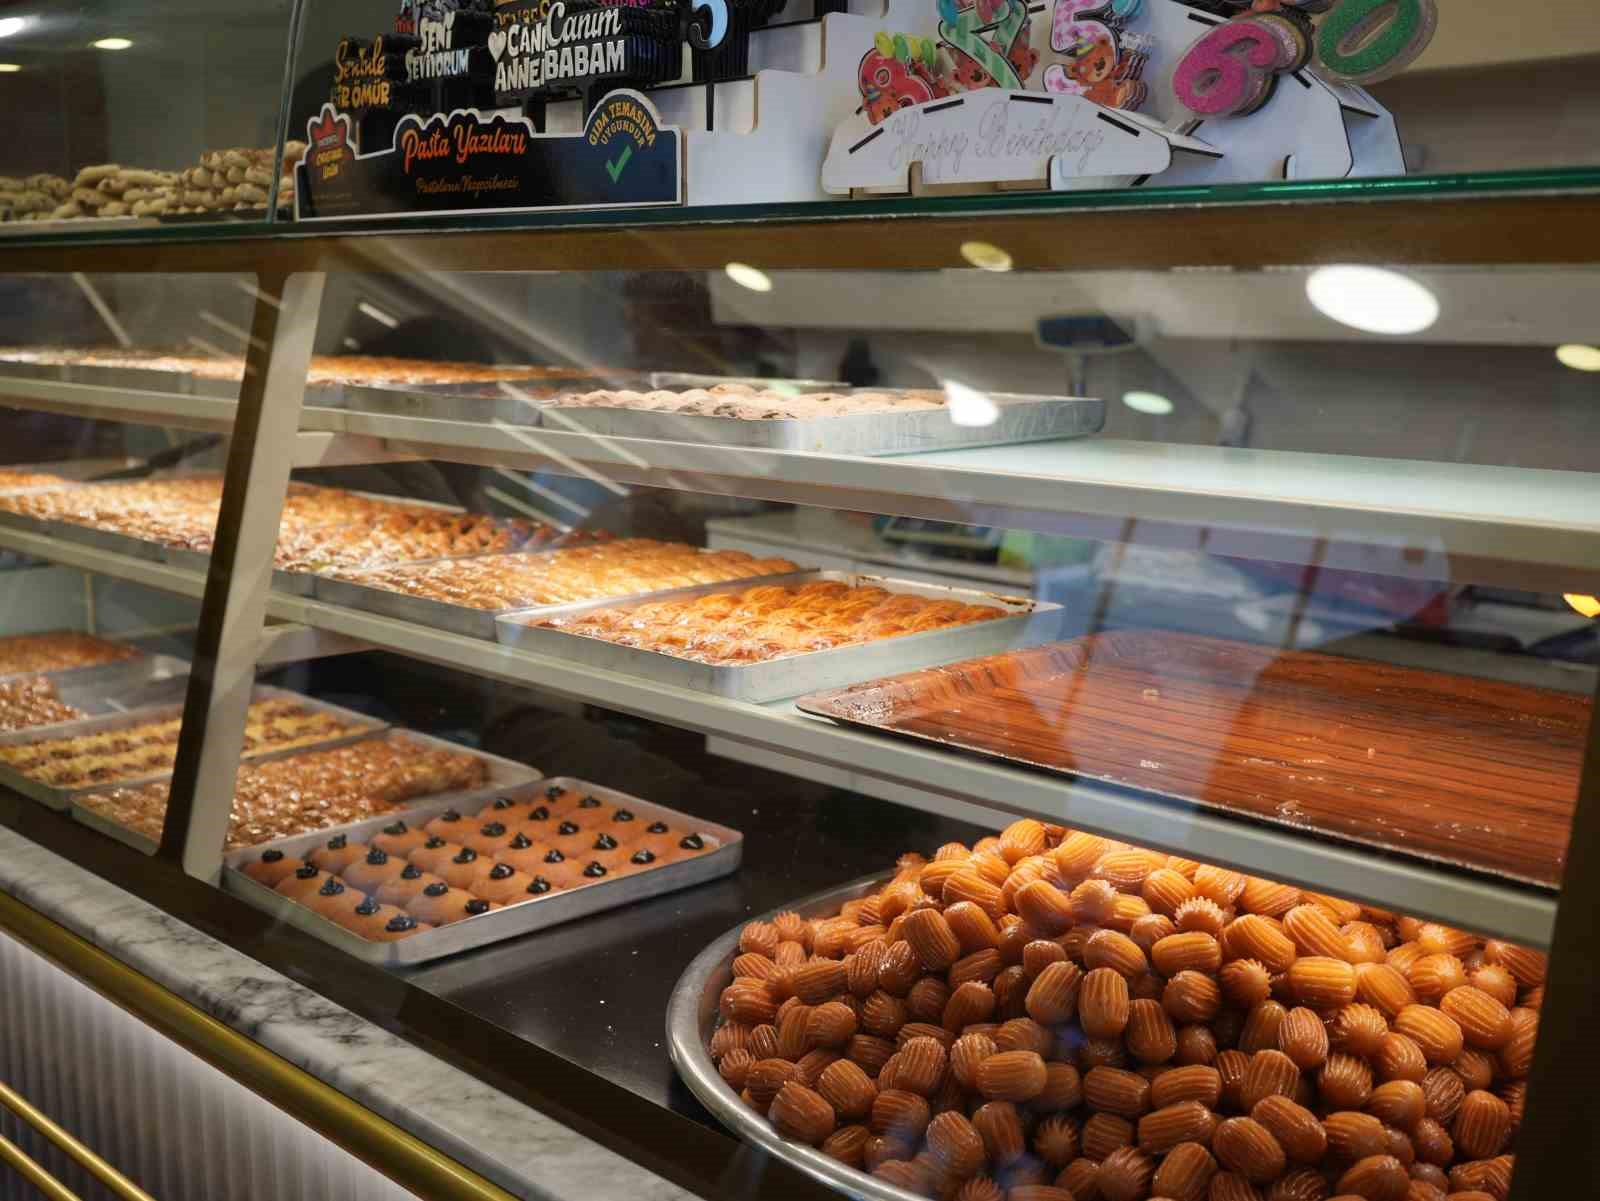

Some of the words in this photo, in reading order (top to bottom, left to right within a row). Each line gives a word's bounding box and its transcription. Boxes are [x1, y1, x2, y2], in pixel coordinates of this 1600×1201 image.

[507, 23, 549, 57] CANI
[546, 2, 622, 47] Canım
[545, 40, 625, 80] BABAM
[608, 101, 656, 147] TEMASINA
[975, 103, 1105, 172] Birthday
[401, 128, 450, 174] Pasta
[454, 123, 528, 163] Yazıları
